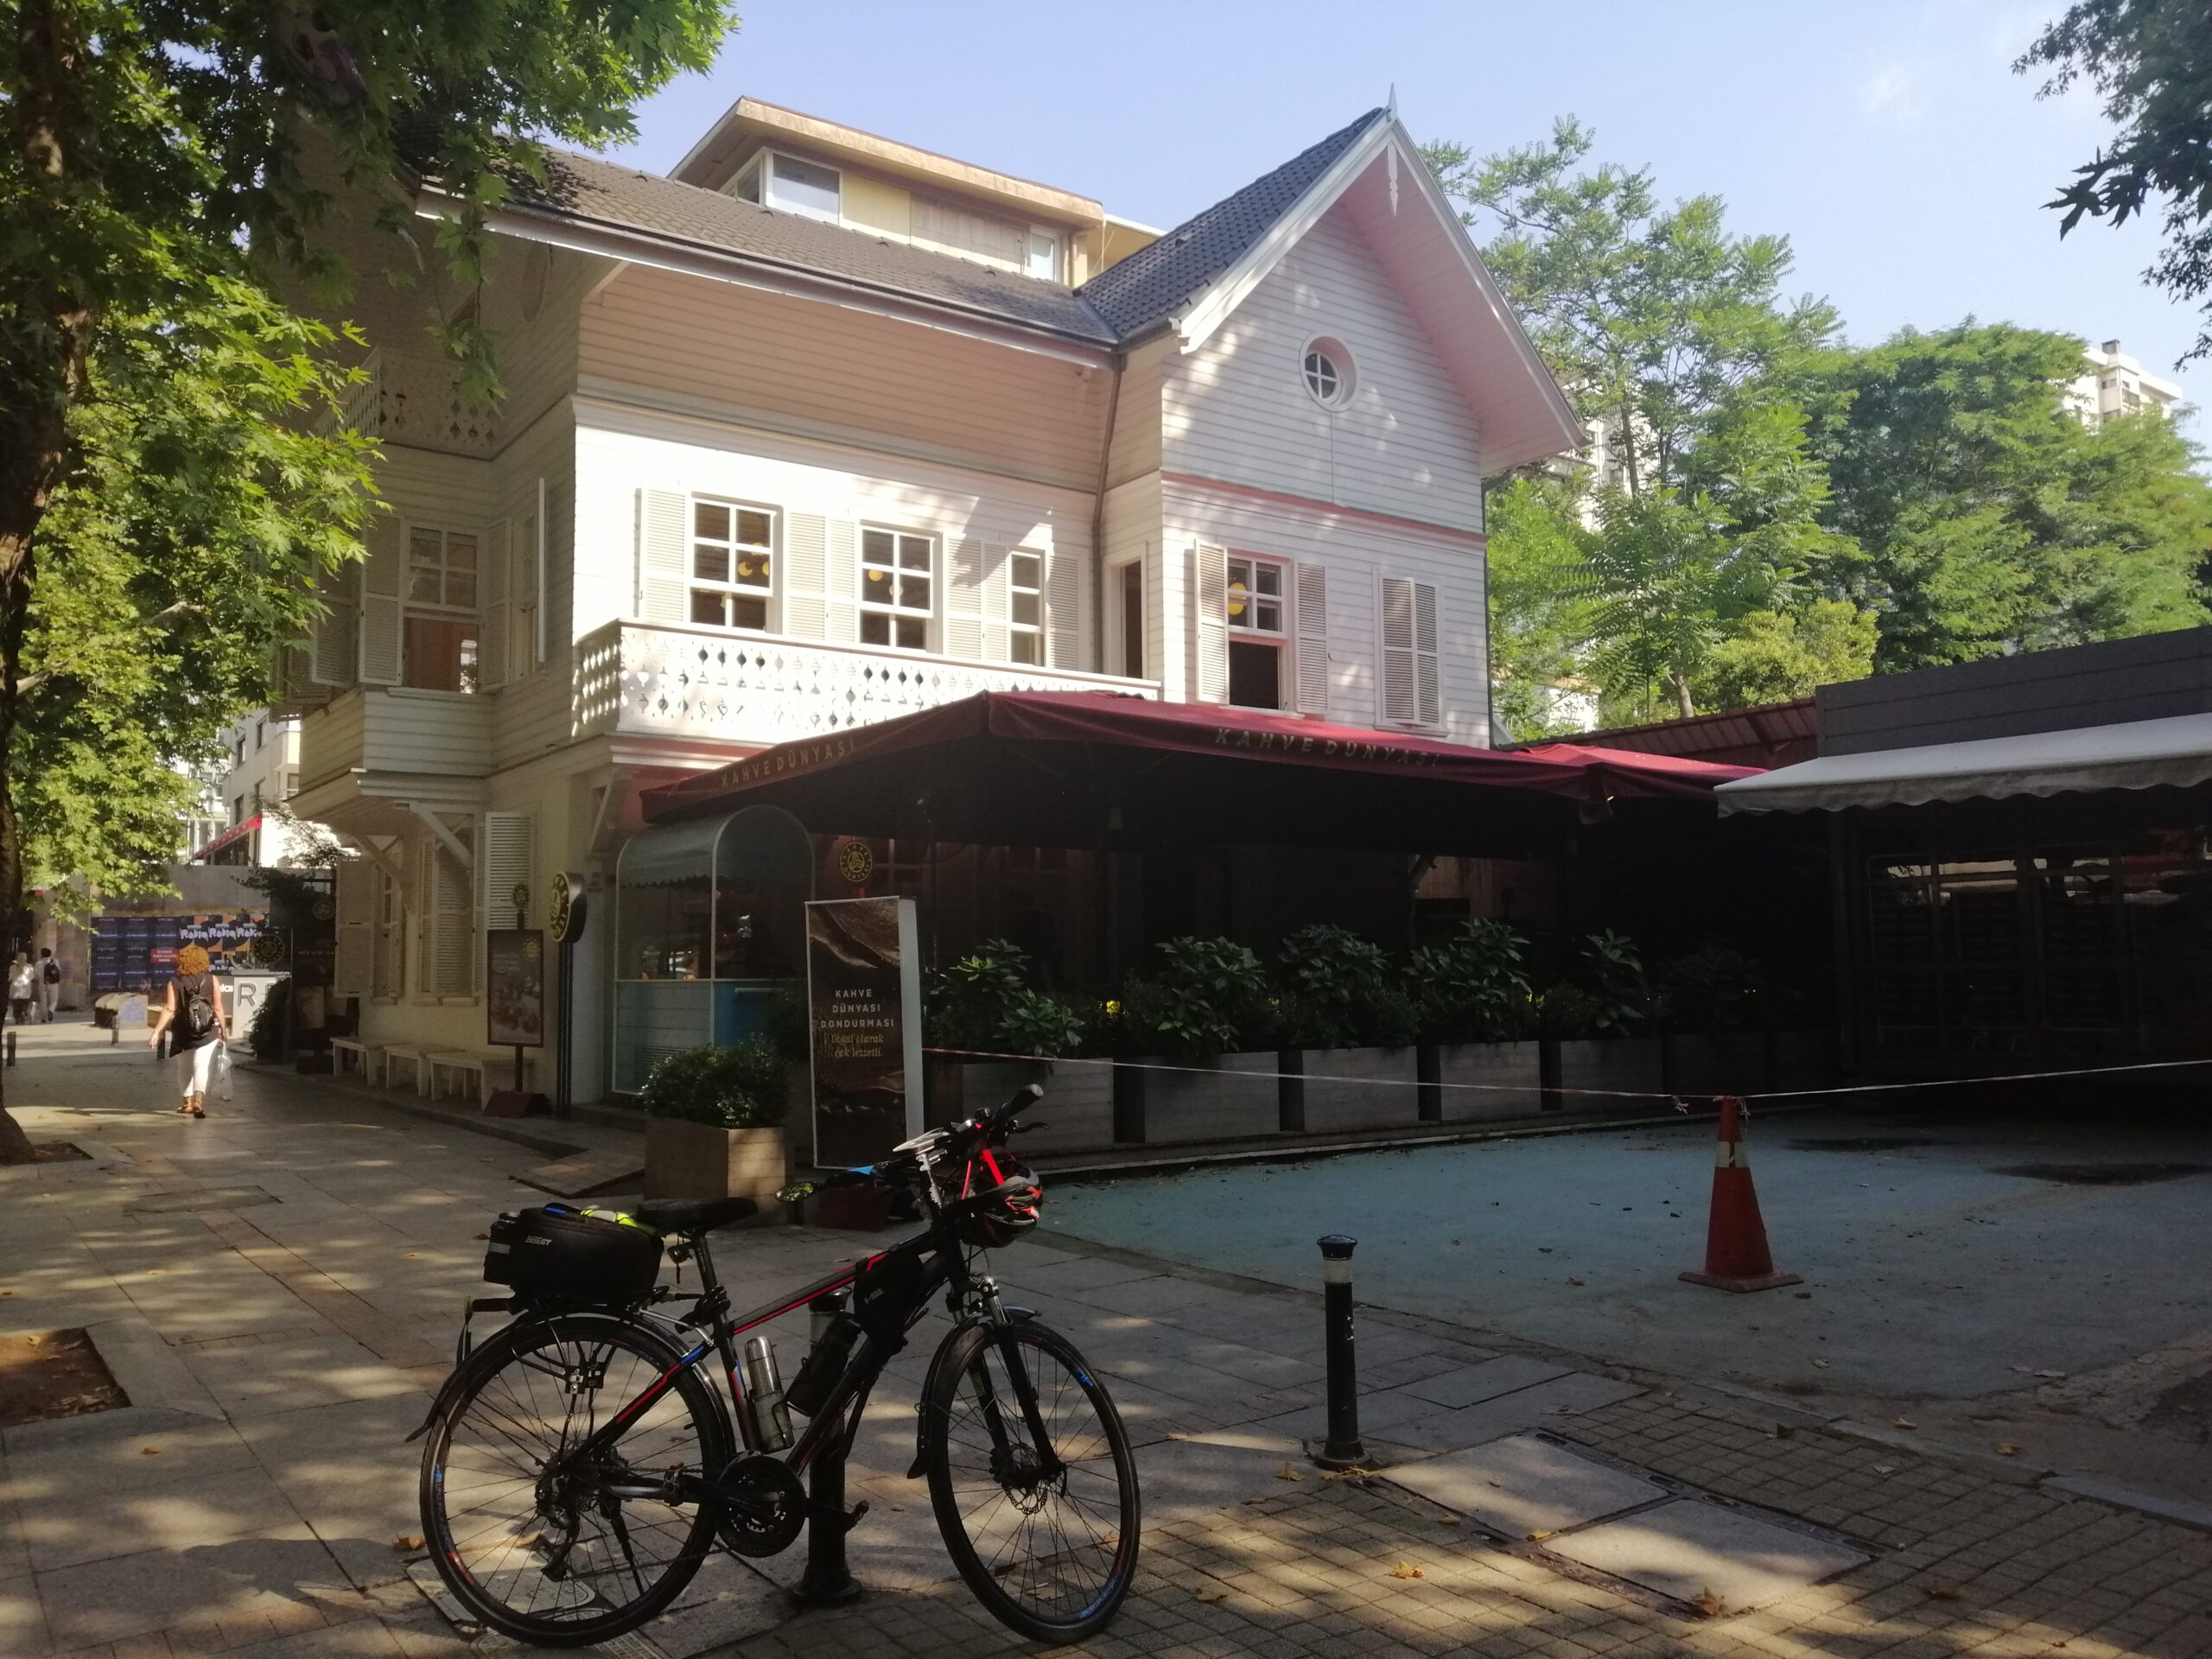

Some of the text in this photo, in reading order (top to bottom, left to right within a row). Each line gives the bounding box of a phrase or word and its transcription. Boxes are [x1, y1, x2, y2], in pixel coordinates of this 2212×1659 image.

[1215, 728, 1314, 753] KAHVE
[721, 739, 855, 789] KAHVE DÜNYASI
[836, 988, 872, 998] KAHVE
[832, 1003, 880, 1013] DÜNYASI
[820, 1019, 894, 1028] DONDURMASI
[856, 1033, 884, 1044] olarak
